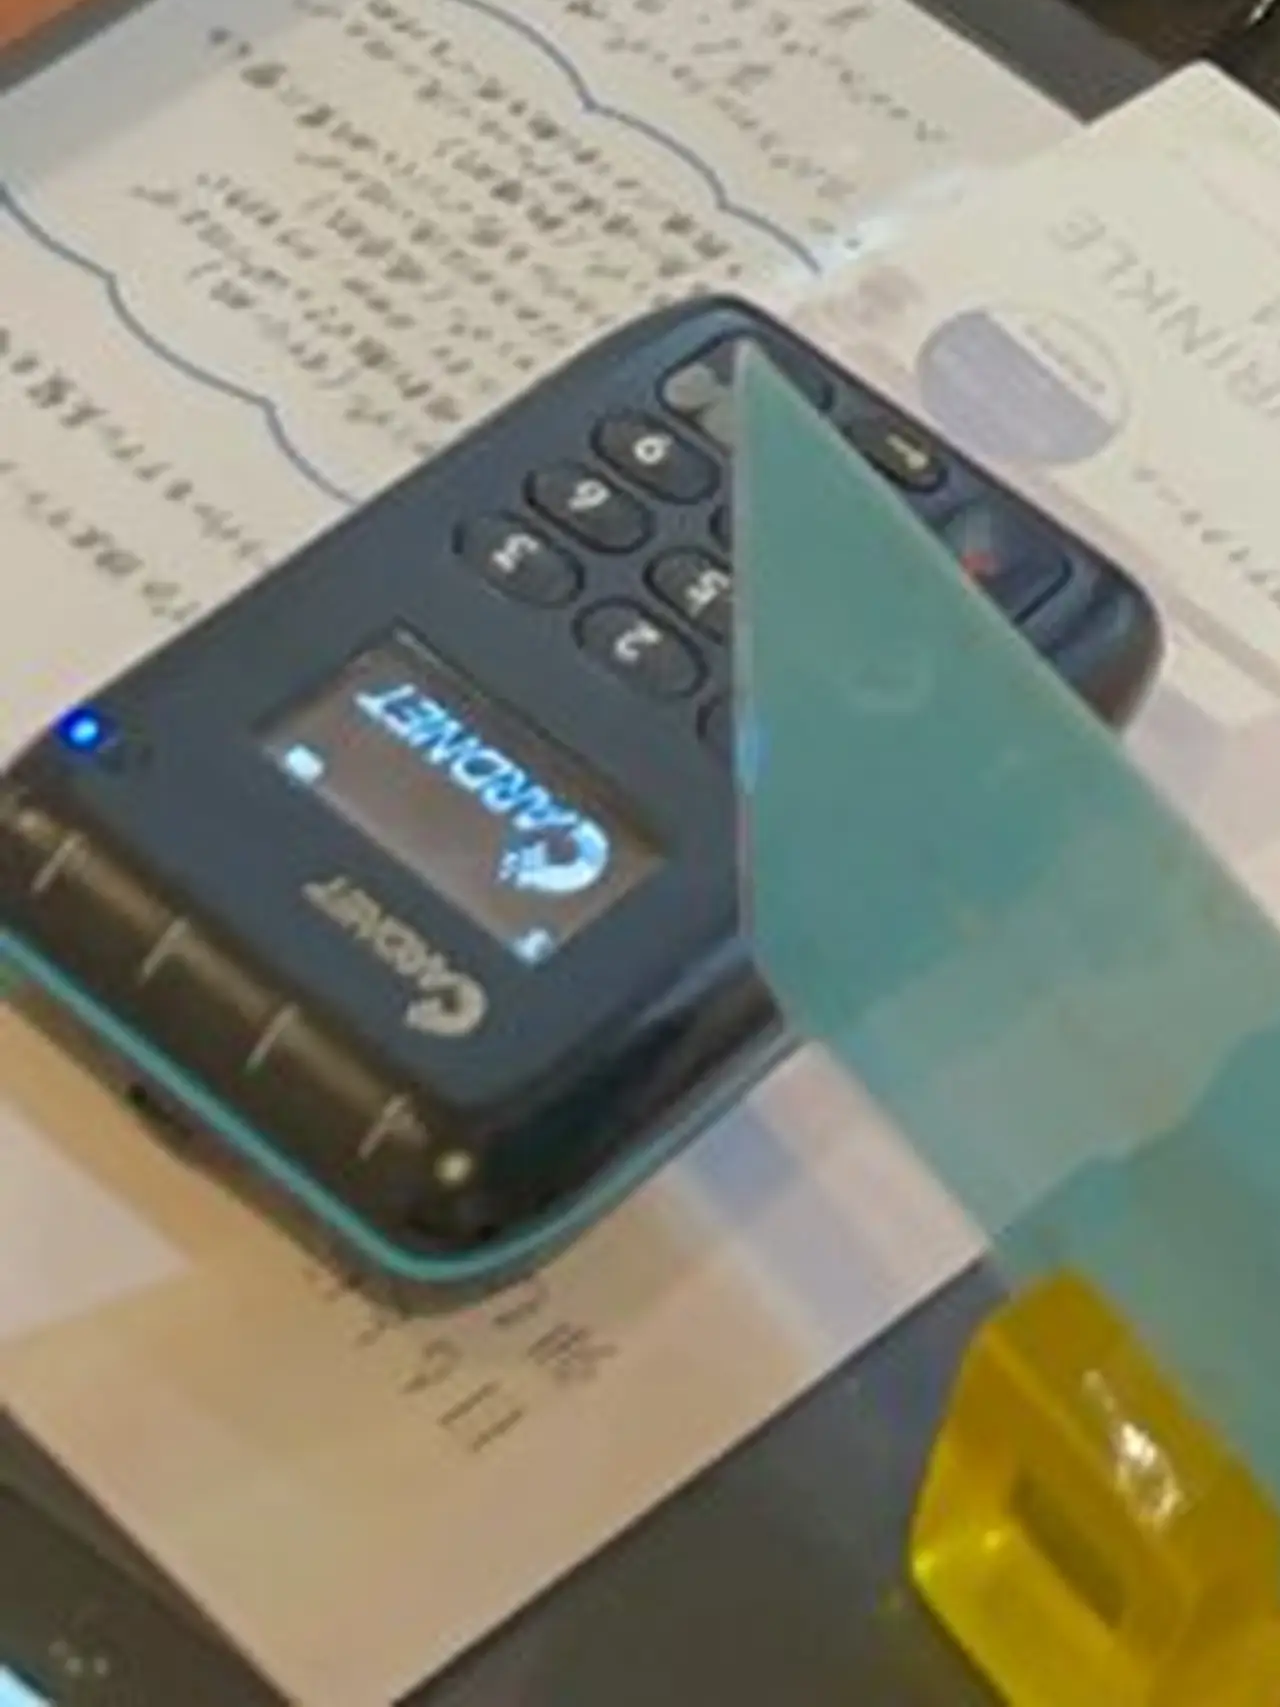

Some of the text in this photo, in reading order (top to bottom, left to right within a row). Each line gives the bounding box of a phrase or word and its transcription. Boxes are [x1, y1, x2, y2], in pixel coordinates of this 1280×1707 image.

[630, 433, 674, 467] 9
[488, 532, 662, 663] 2 3
[566, 480, 732, 605] 5 6
[354, 683, 611, 893] CARDNET
[301, 874, 489, 1038] CARDNET
